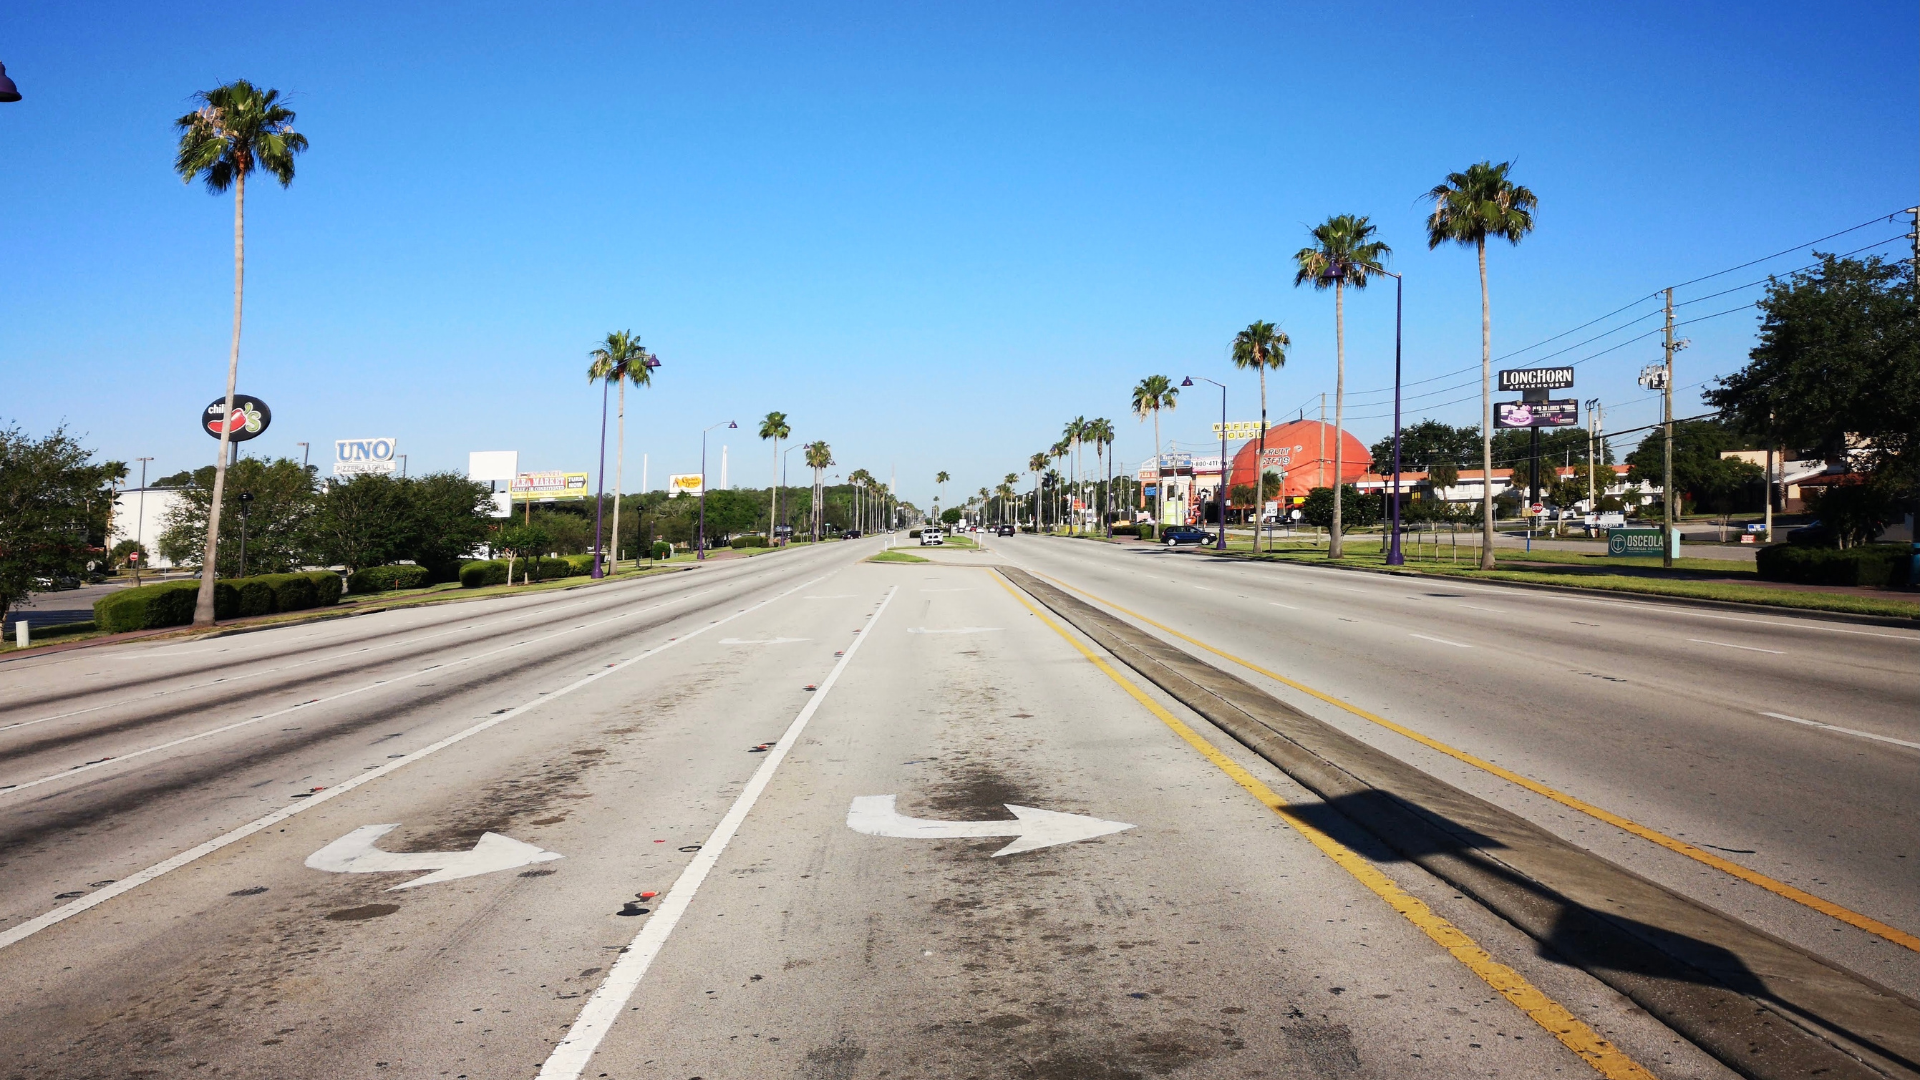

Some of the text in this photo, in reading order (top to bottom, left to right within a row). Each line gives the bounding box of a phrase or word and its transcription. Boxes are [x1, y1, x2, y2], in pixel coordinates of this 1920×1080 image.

[1503, 369, 1571, 385] LONGHORN
[1213, 422, 1270, 431] WAFFLE
[338, 440, 390, 461] UNO
[336, 464, 366, 473] PIZZERIA
[372, 463, 390, 471] GRILL
[512, 477, 565, 487] FLEA MARKET
[1627, 535, 1664, 547] OSCEOLA
